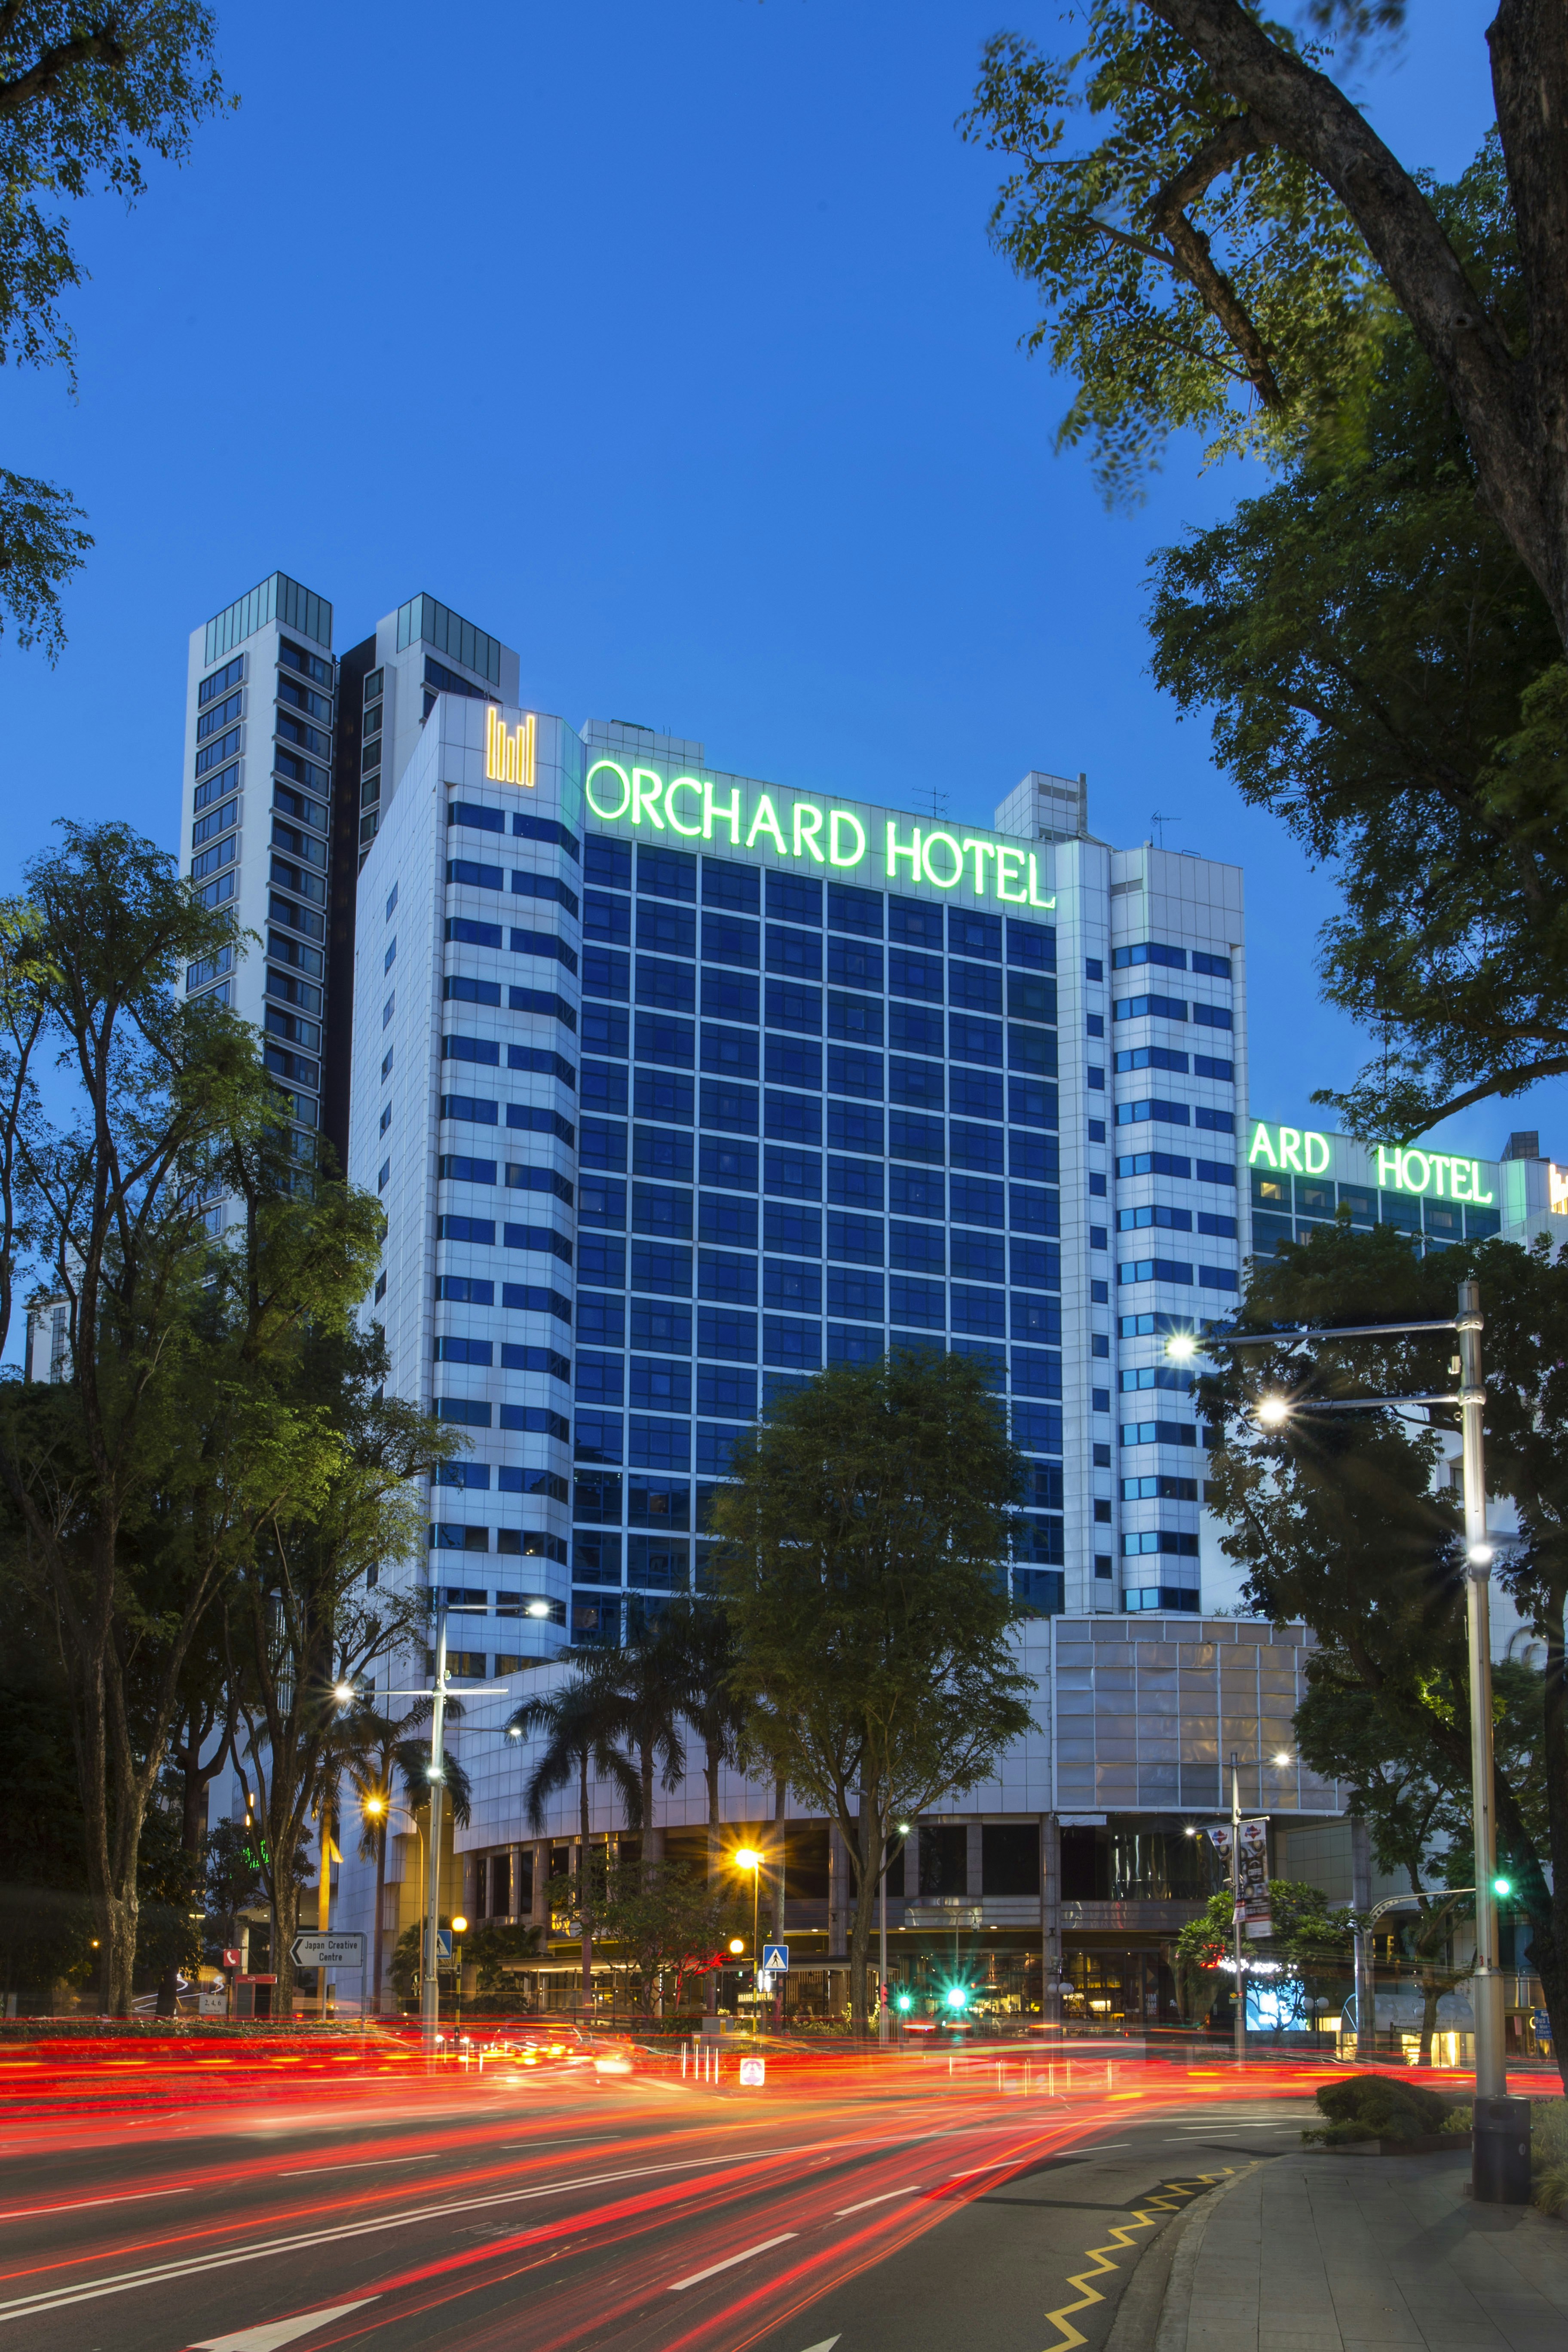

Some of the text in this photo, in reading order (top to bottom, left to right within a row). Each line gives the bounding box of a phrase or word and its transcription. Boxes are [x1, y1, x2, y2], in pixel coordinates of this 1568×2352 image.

[586, 760, 1056, 909] ORCHARD HOTEL
[1249, 1122, 1493, 1204] ARD HOTEL
[305, 1941, 357, 1951] Japan Creative
[319, 1953, 342, 1961] Centre
[738, 1994, 753, 2002] ORANGE
